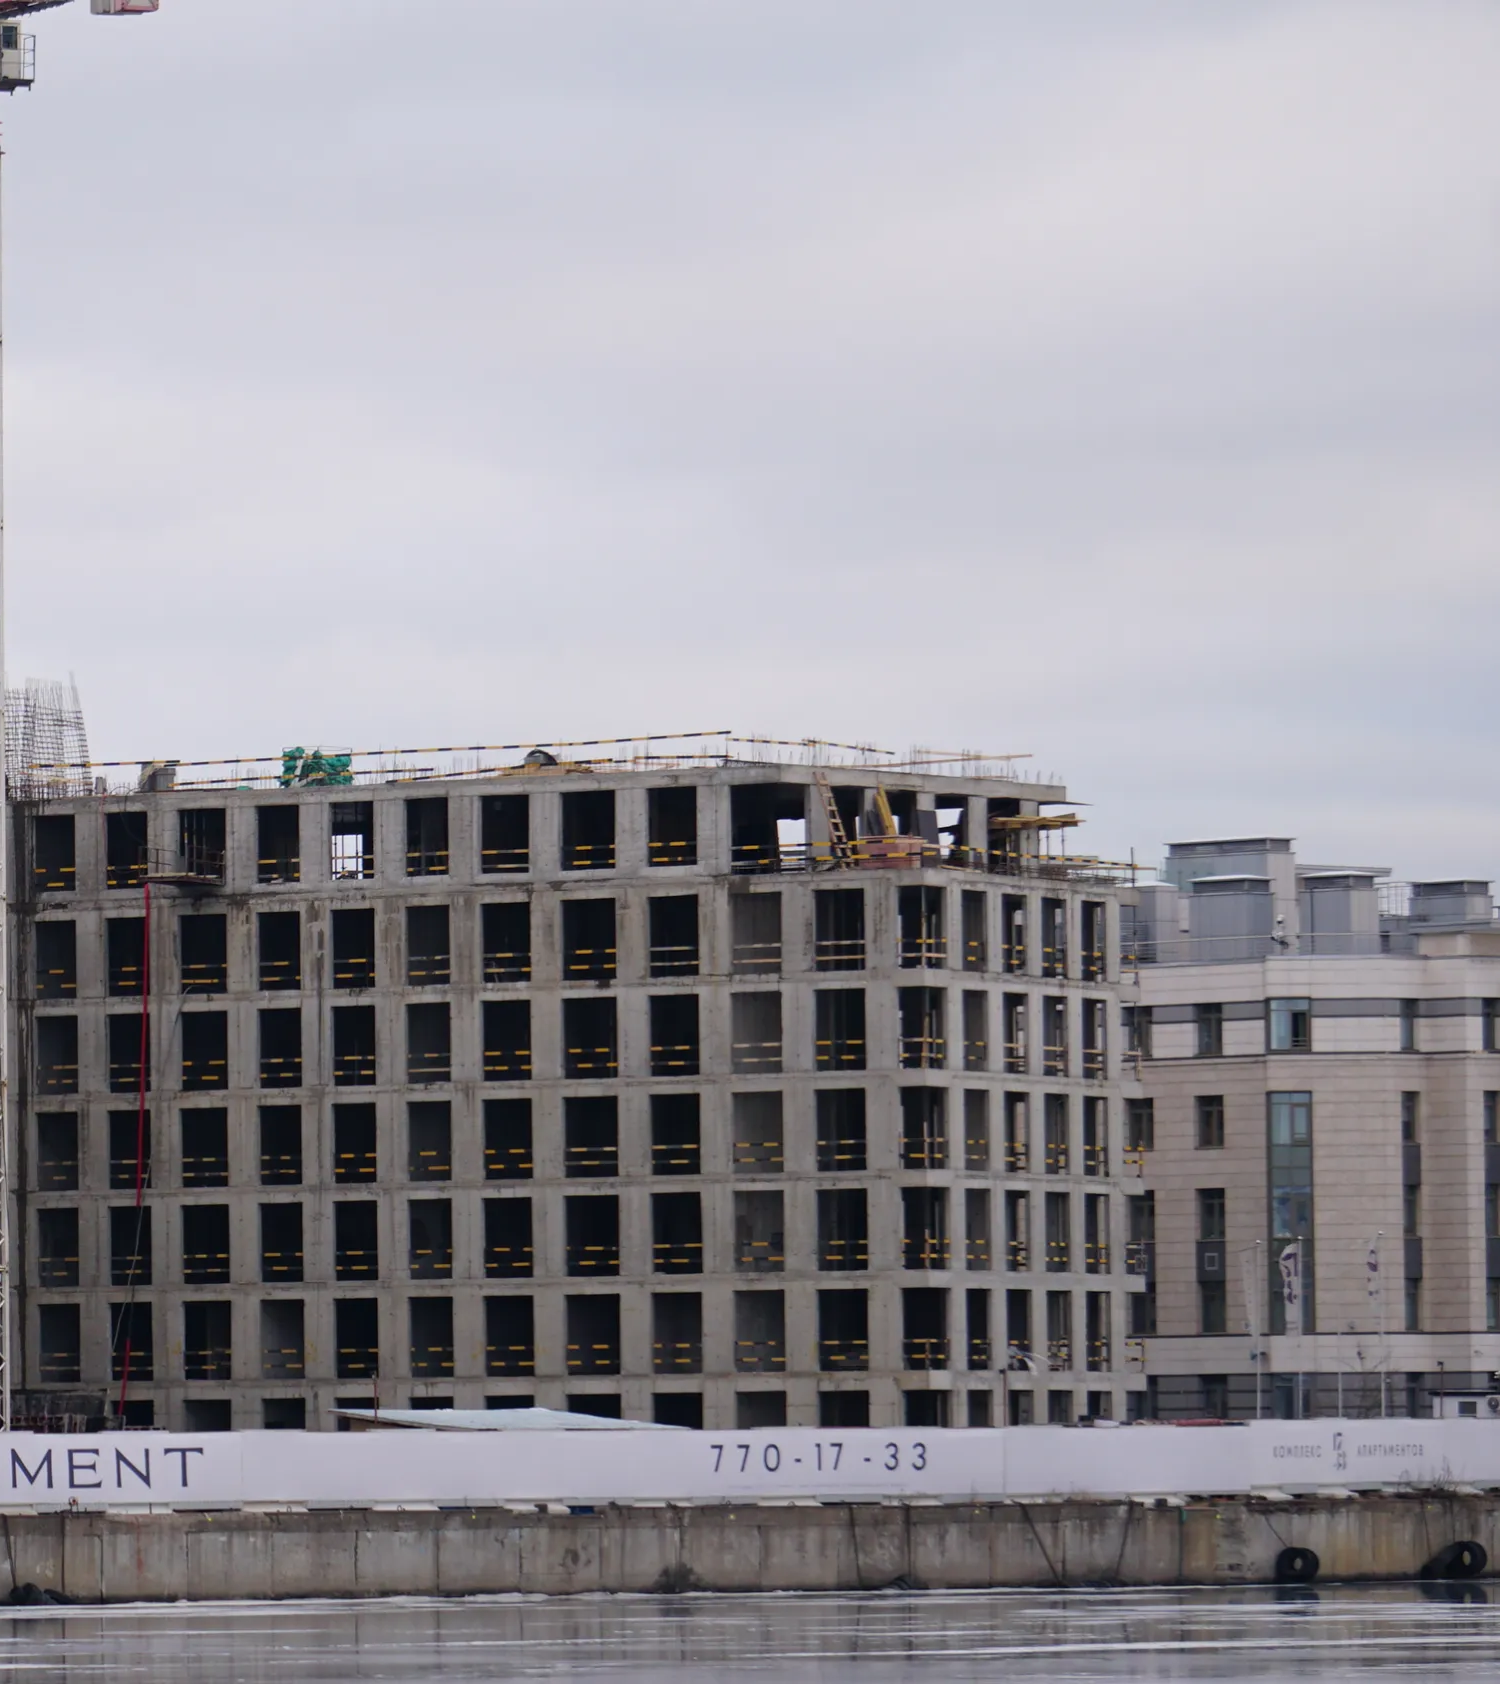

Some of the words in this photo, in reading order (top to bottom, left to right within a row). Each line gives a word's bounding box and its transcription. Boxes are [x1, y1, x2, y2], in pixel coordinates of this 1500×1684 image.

[709, 1441, 928, 1473] 770-17-33
[1272, 1445, 1322, 1459] КОМПЛЕКС
[1356, 1443, 1424, 1457] АПАРТАМЕНТОВ
